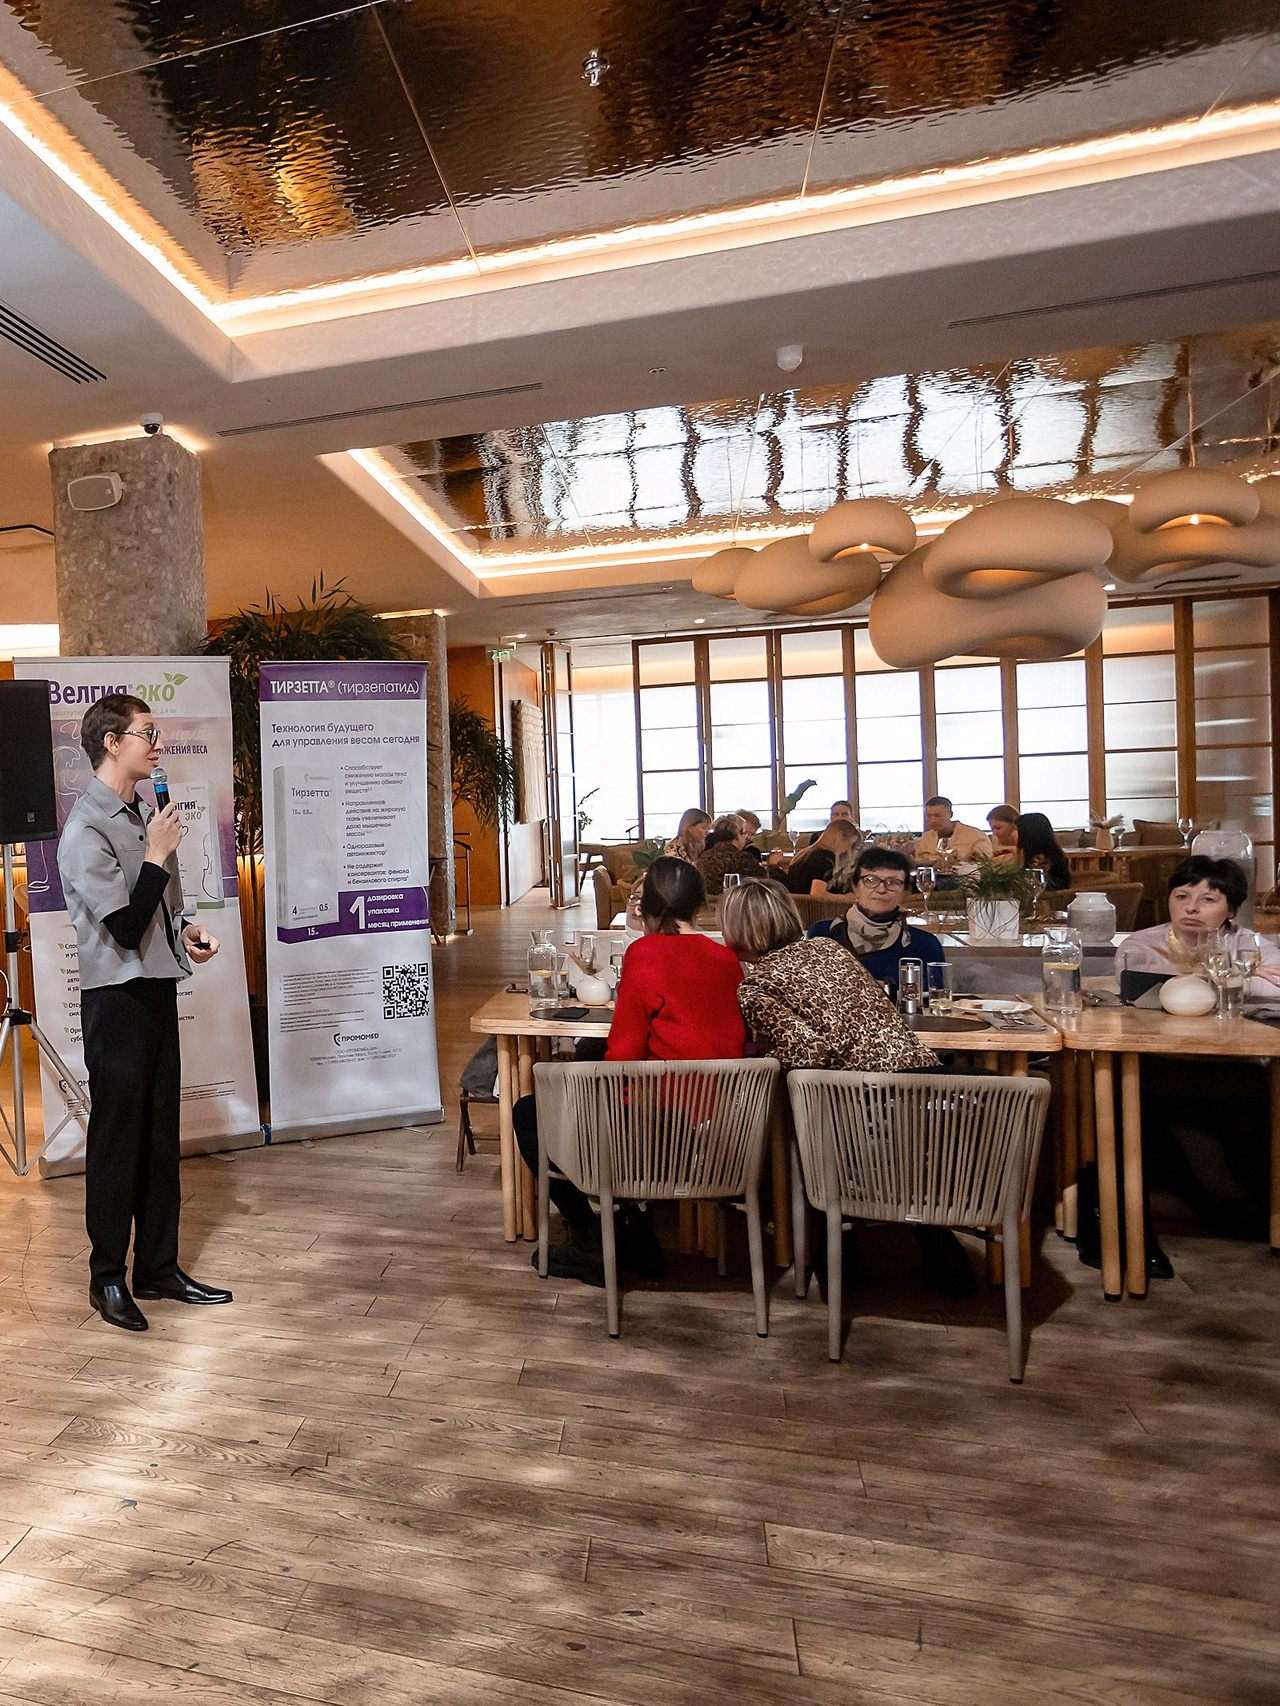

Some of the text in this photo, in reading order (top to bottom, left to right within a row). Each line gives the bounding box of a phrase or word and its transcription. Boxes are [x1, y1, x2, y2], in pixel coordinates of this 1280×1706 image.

[135, 683, 176, 702] эко
[337, 680, 420, 696] (тирзепатид)
[272, 722, 374, 734] Технология будущего
[272, 735, 420, 748] для управления весом сегодня
[192, 744, 208, 755] ВЕСА
[185, 811, 202, 821] эко
[367, 893, 404, 903] дозировка
[349, 896, 365, 929] 1
[367, 907, 400, 916] упаковка
[367, 920, 390, 929] месяц
